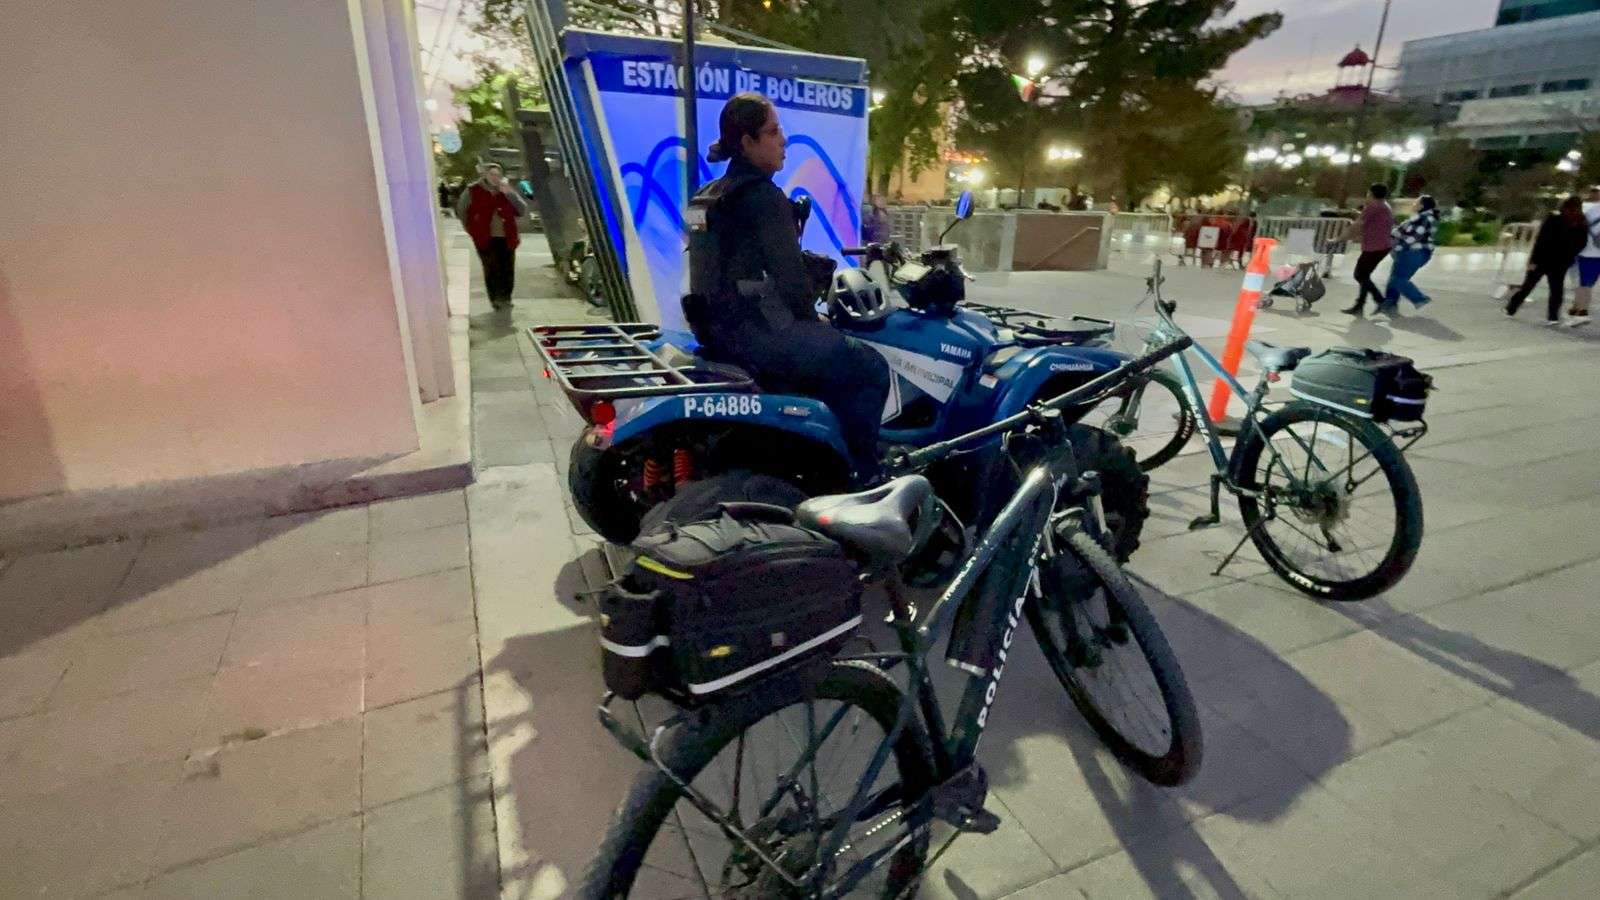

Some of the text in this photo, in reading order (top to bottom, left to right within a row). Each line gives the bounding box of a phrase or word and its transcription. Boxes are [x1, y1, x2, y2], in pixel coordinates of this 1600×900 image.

[735, 69, 761, 96] DE
[766, 76, 853, 110] BOLEROS
[940, 342, 972, 359] YAMAHA
[684, 395, 762, 418] P-64886
